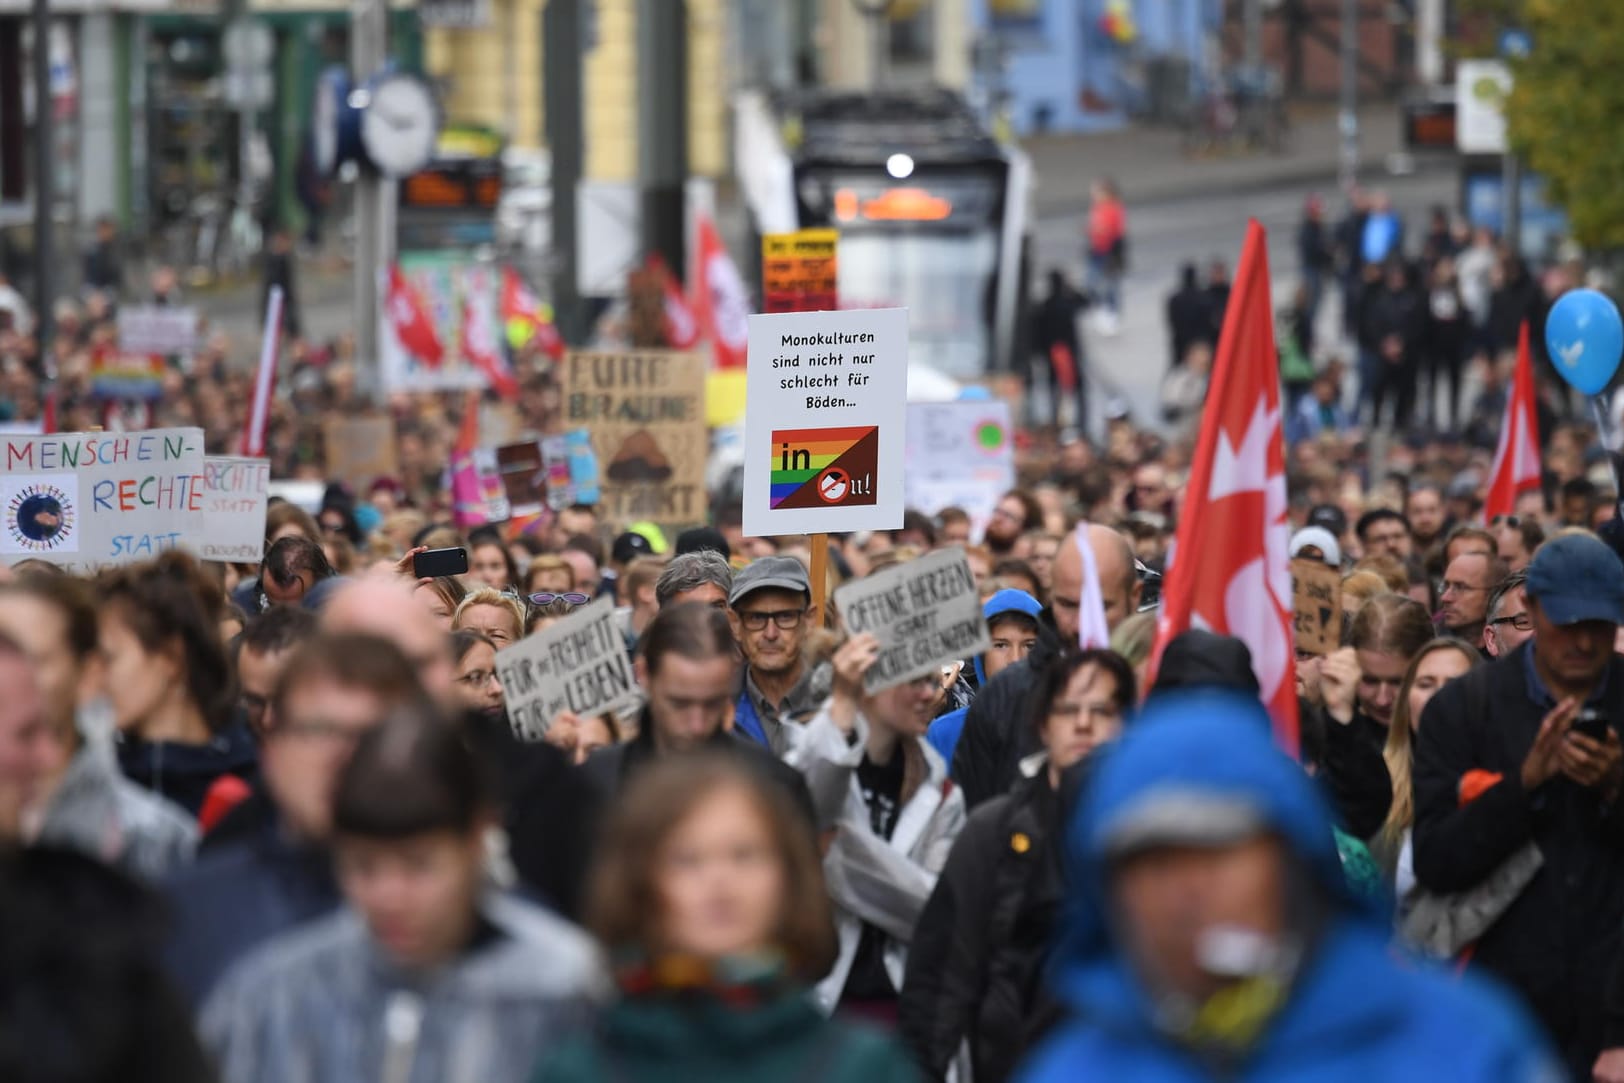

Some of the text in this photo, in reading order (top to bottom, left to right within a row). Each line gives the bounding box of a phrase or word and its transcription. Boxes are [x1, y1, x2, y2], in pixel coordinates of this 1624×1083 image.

[782, 332, 875, 347] Monokulturen
[772, 353, 875, 369] sind nicht nur
[780, 373, 869, 389] schlecht für
[806, 395, 856, 409] Böden...
[8, 436, 195, 471] MENSCHEN-
[782, 443, 810, 471] in
[93, 475, 205, 512] RECHTE
[111, 532, 182, 556] STATT
[848, 560, 975, 632] OFFENE HERZEN
[502, 657, 538, 699] FÜR
[549, 613, 615, 678] FREIHEIT
[565, 653, 630, 714] LEBEN
